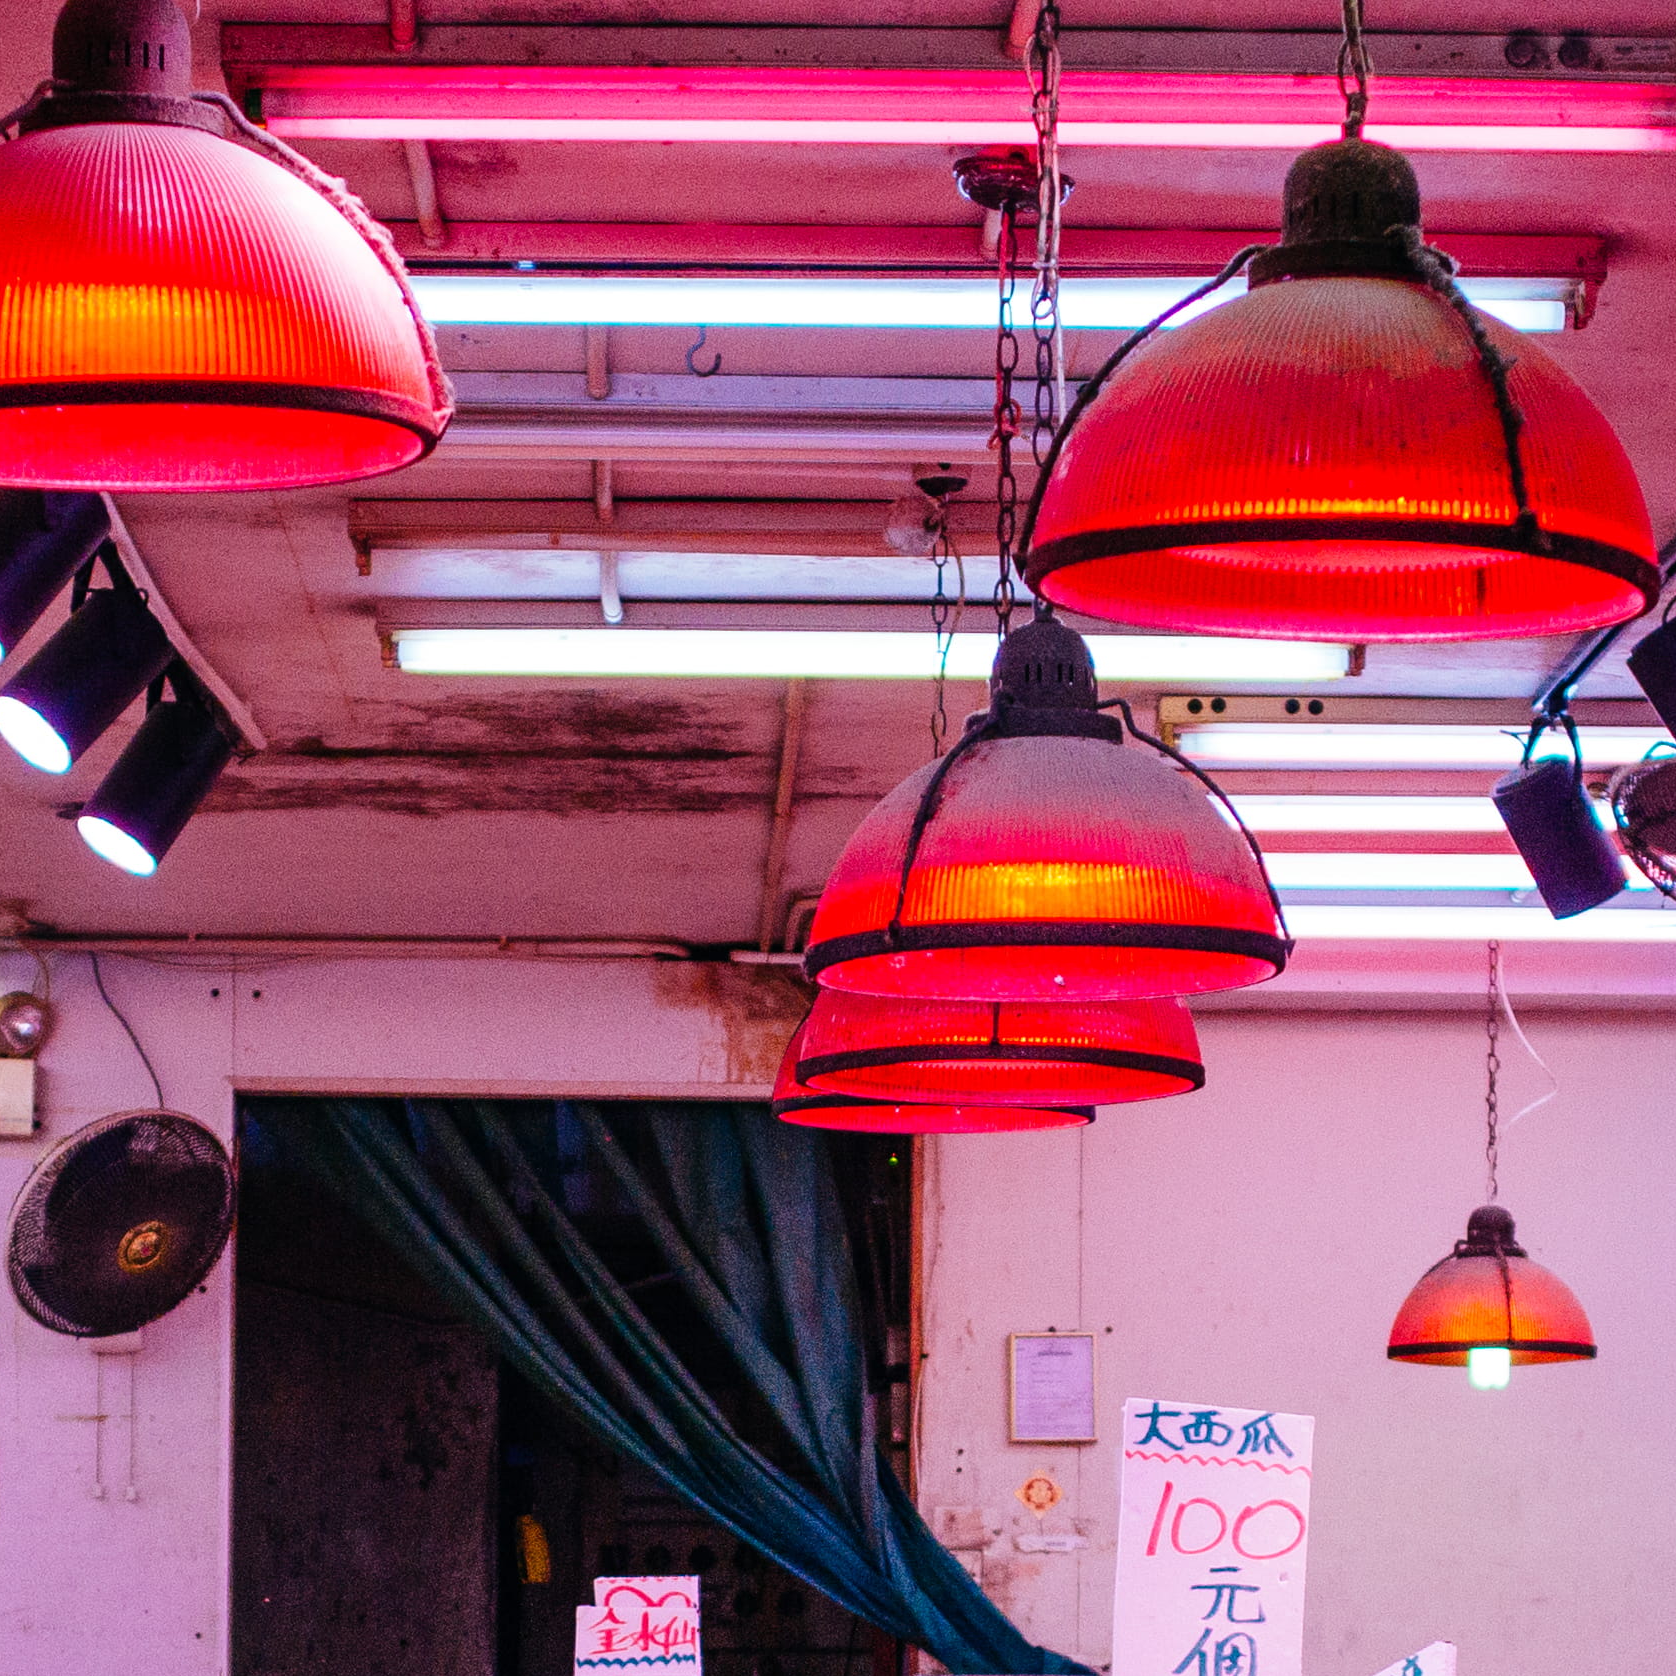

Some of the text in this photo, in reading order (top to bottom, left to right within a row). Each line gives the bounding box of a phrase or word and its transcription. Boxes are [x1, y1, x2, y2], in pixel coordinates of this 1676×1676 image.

[1134, 1402, 1294, 1457] 大西瓜
[1146, 1481, 1306, 1559] 100
